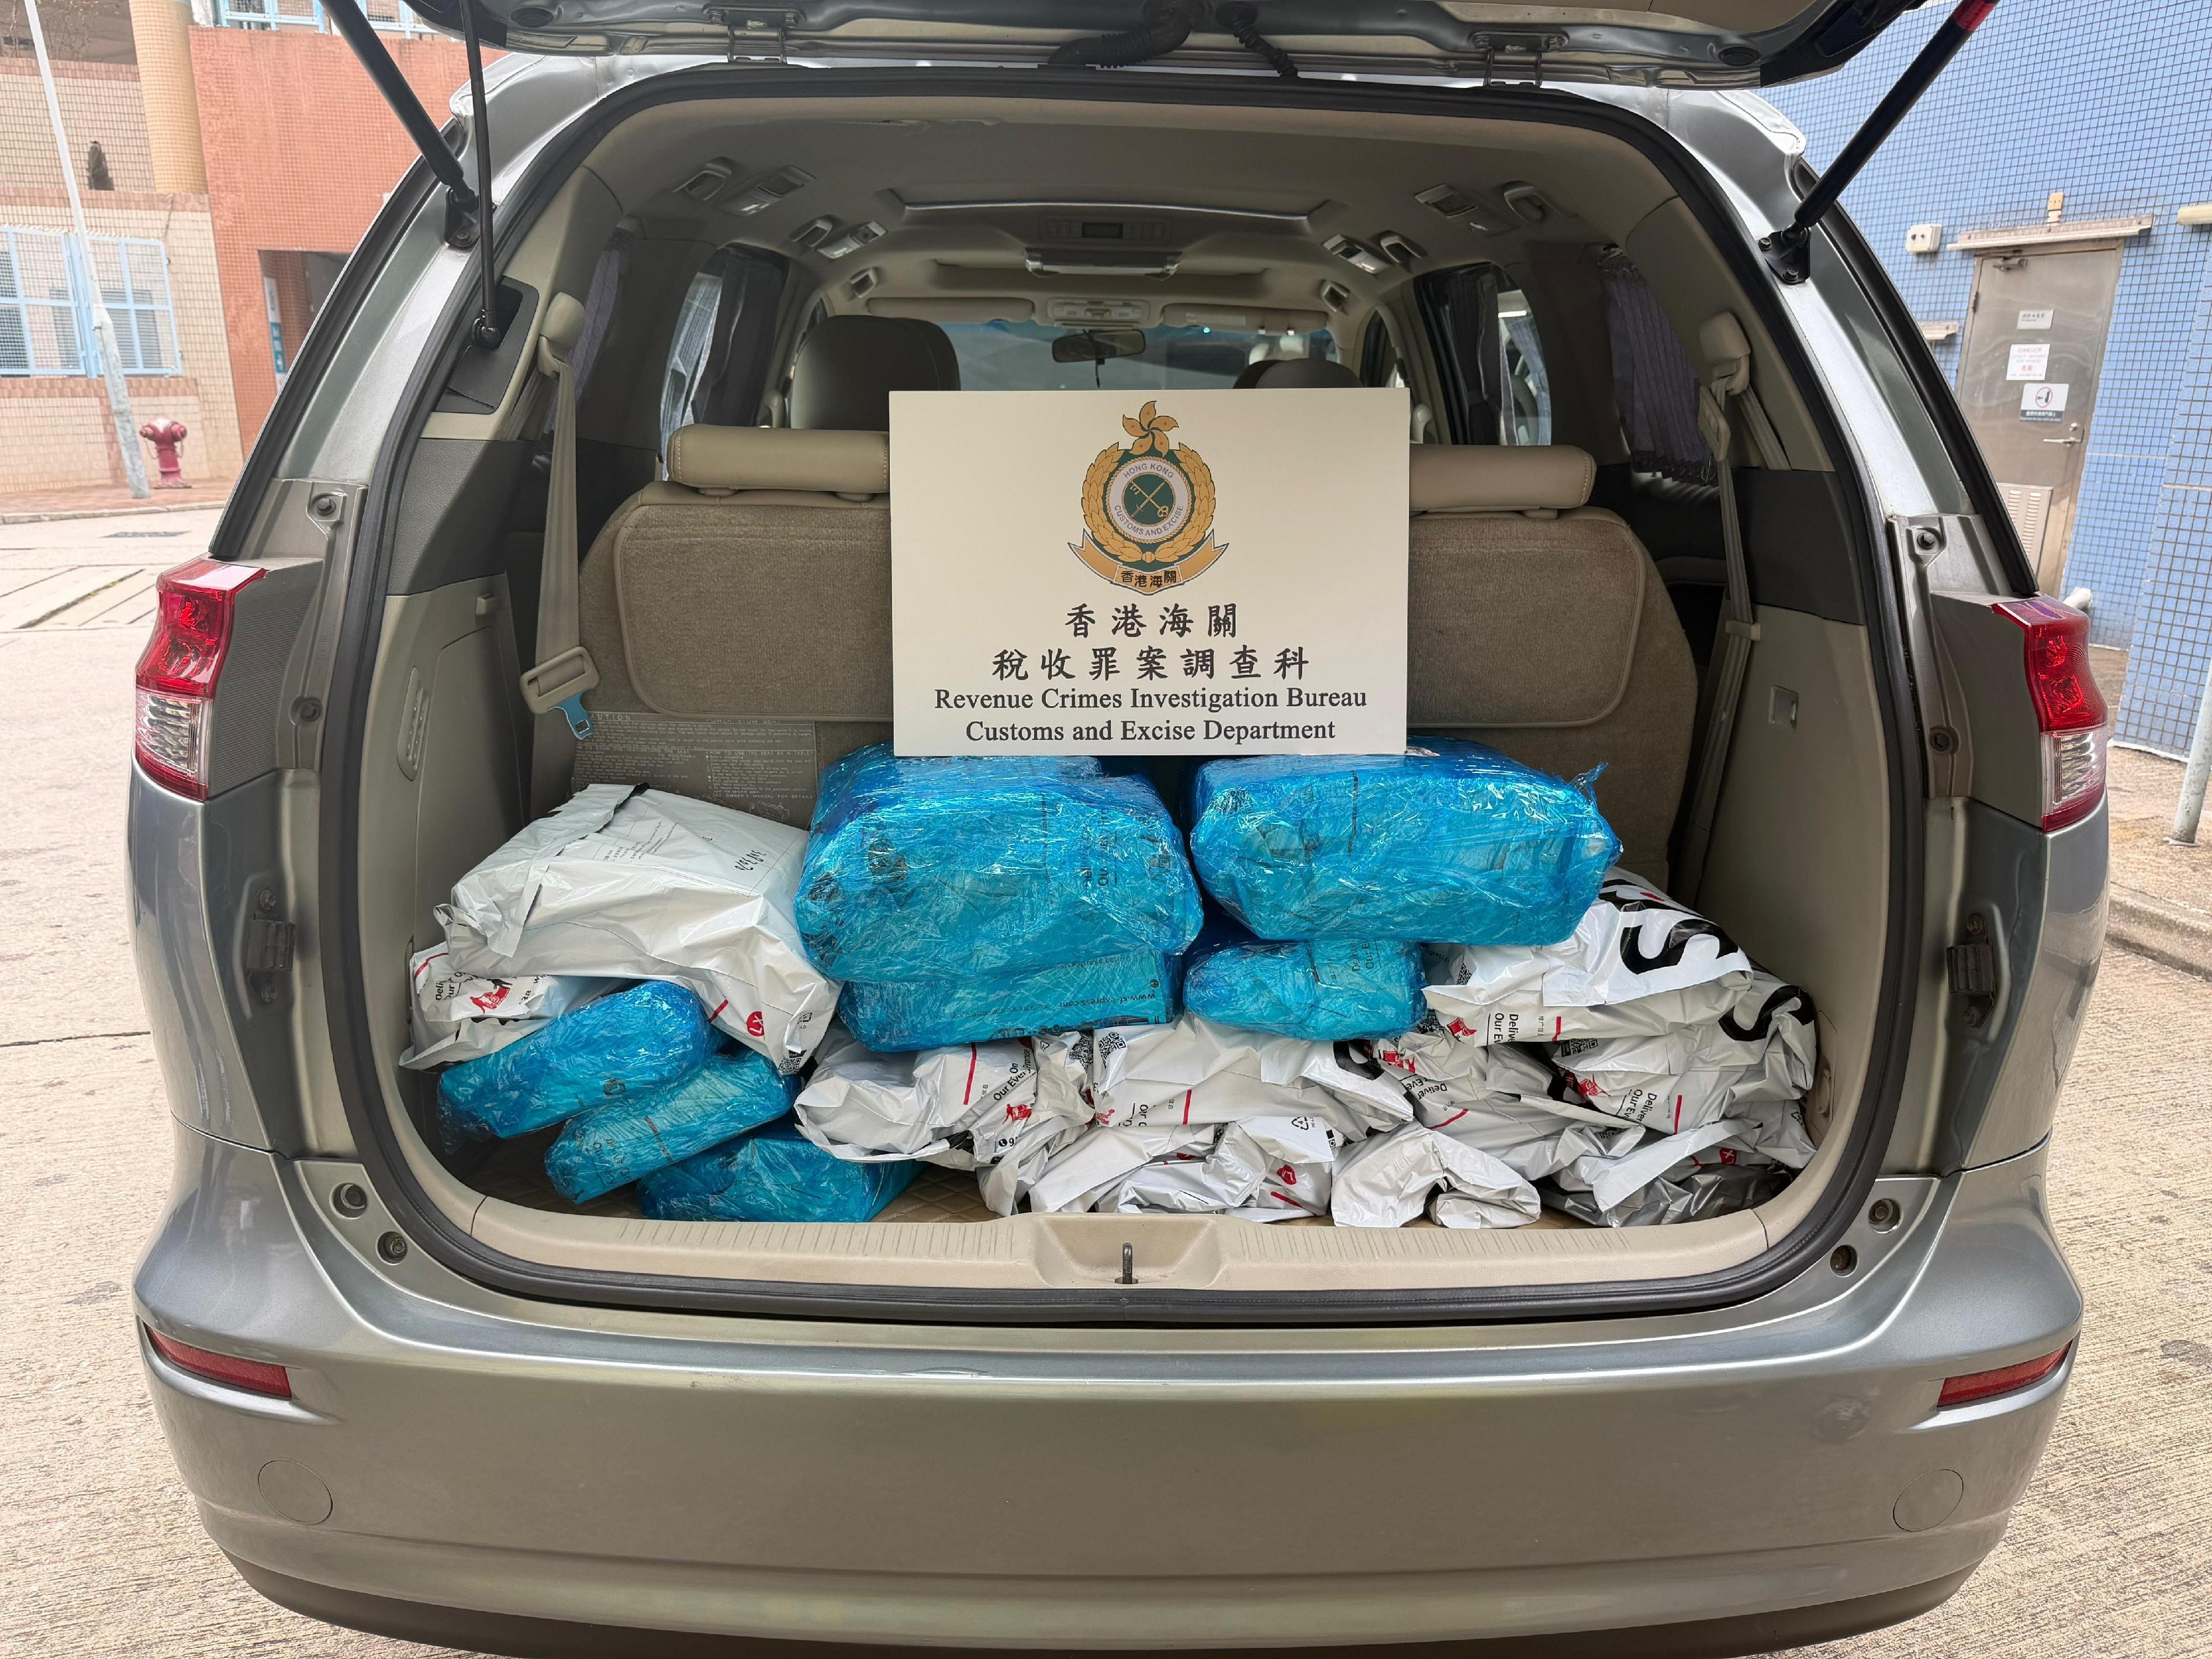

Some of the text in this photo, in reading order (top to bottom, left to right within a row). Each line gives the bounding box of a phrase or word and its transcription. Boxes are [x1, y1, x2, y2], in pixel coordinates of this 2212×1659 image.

[1123, 463, 1174, 479] HONG KONG
[1114, 504, 1184, 536] CUSTOMS AND EXCISE
[1120, 570, 1177, 587] 香港海關
[1065, 603, 1237, 638] 香港海關
[992, 644, 1309, 681] 稅收罪案調查科
[935, 687, 1368, 713] Revenue Crimes Investigation Bureau
[966, 719, 1335, 745] Customs and Excise Department
[1060, 992, 1156, 1008] www.sf-express.com
[1494, 1013, 1505, 1033] Our
[1010, 1063, 1019, 1074] On
[993, 1084, 1010, 1101] Our
[1417, 1082, 1448, 1100] Deliver
[1629, 1089, 1643, 1107] Our
[1635, 1093, 1657, 1123] Deliver
